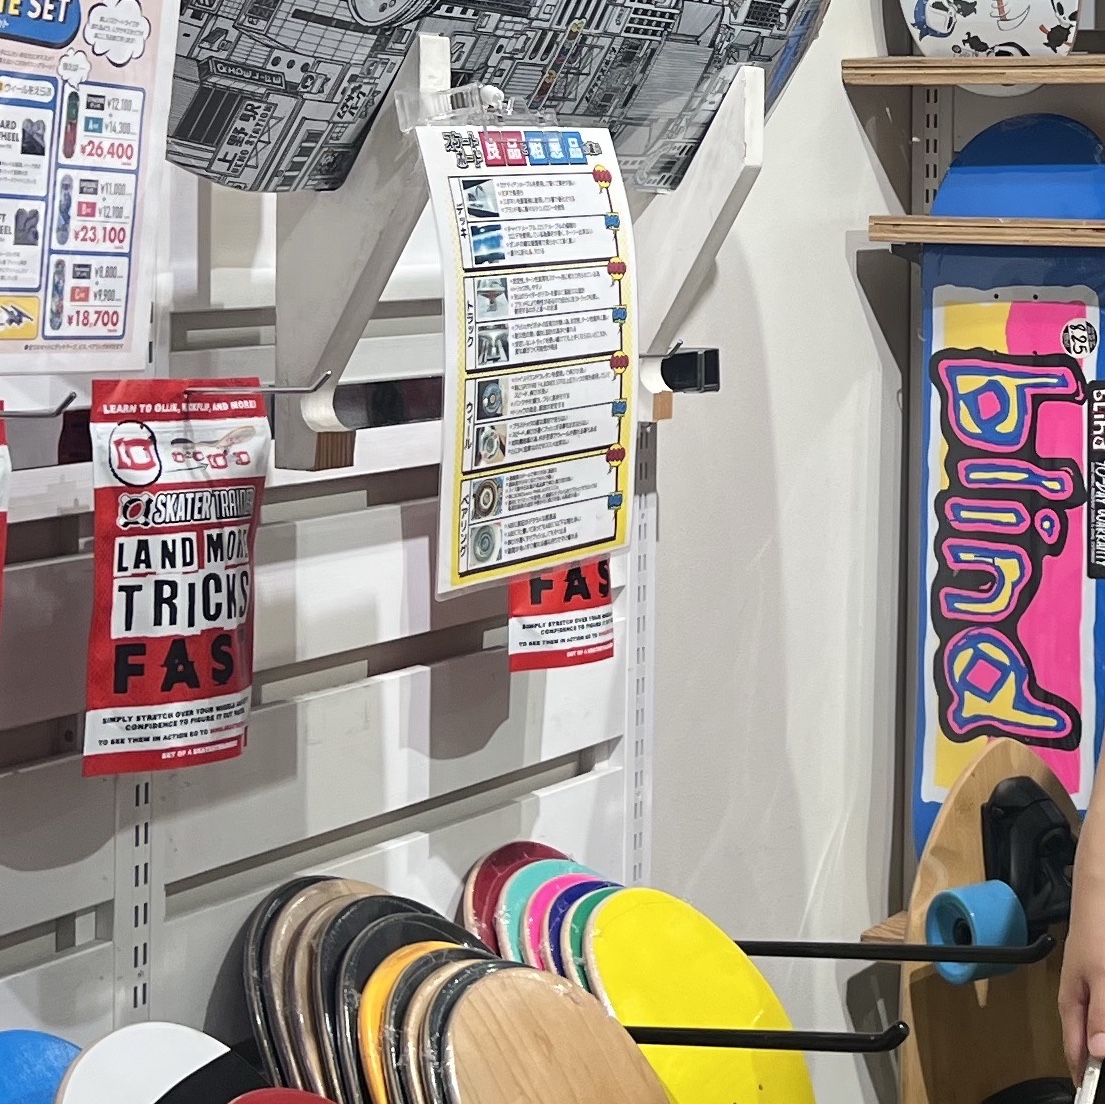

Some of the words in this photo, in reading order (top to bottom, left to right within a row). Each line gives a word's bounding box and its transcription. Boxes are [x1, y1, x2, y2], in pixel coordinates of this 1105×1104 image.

[27, 0, 71, 22] SET
[80, 139, 135, 161] ¥26,400
[73, 225, 127, 245] ¥23,100
[456, 202, 468, 239] デッキ
[67, 309, 120, 328] ¥18,700
[466, 300, 474, 348] トラック
[1069, 323, 1088, 355] 8.25
[103, 403, 136, 415] LEARN
[139, 403, 152, 413] TO
[212, 401, 228, 411] AND
[464, 401, 474, 450] ウィール
[153, 489, 211, 524] SKATER
[117, 536, 196, 573] LAND
[931, 350, 1083, 748] blind
[117, 570, 249, 632] TRICKS
[113, 634, 234, 694] FAS
[125, 720, 177, 731] CONFIDENCE
